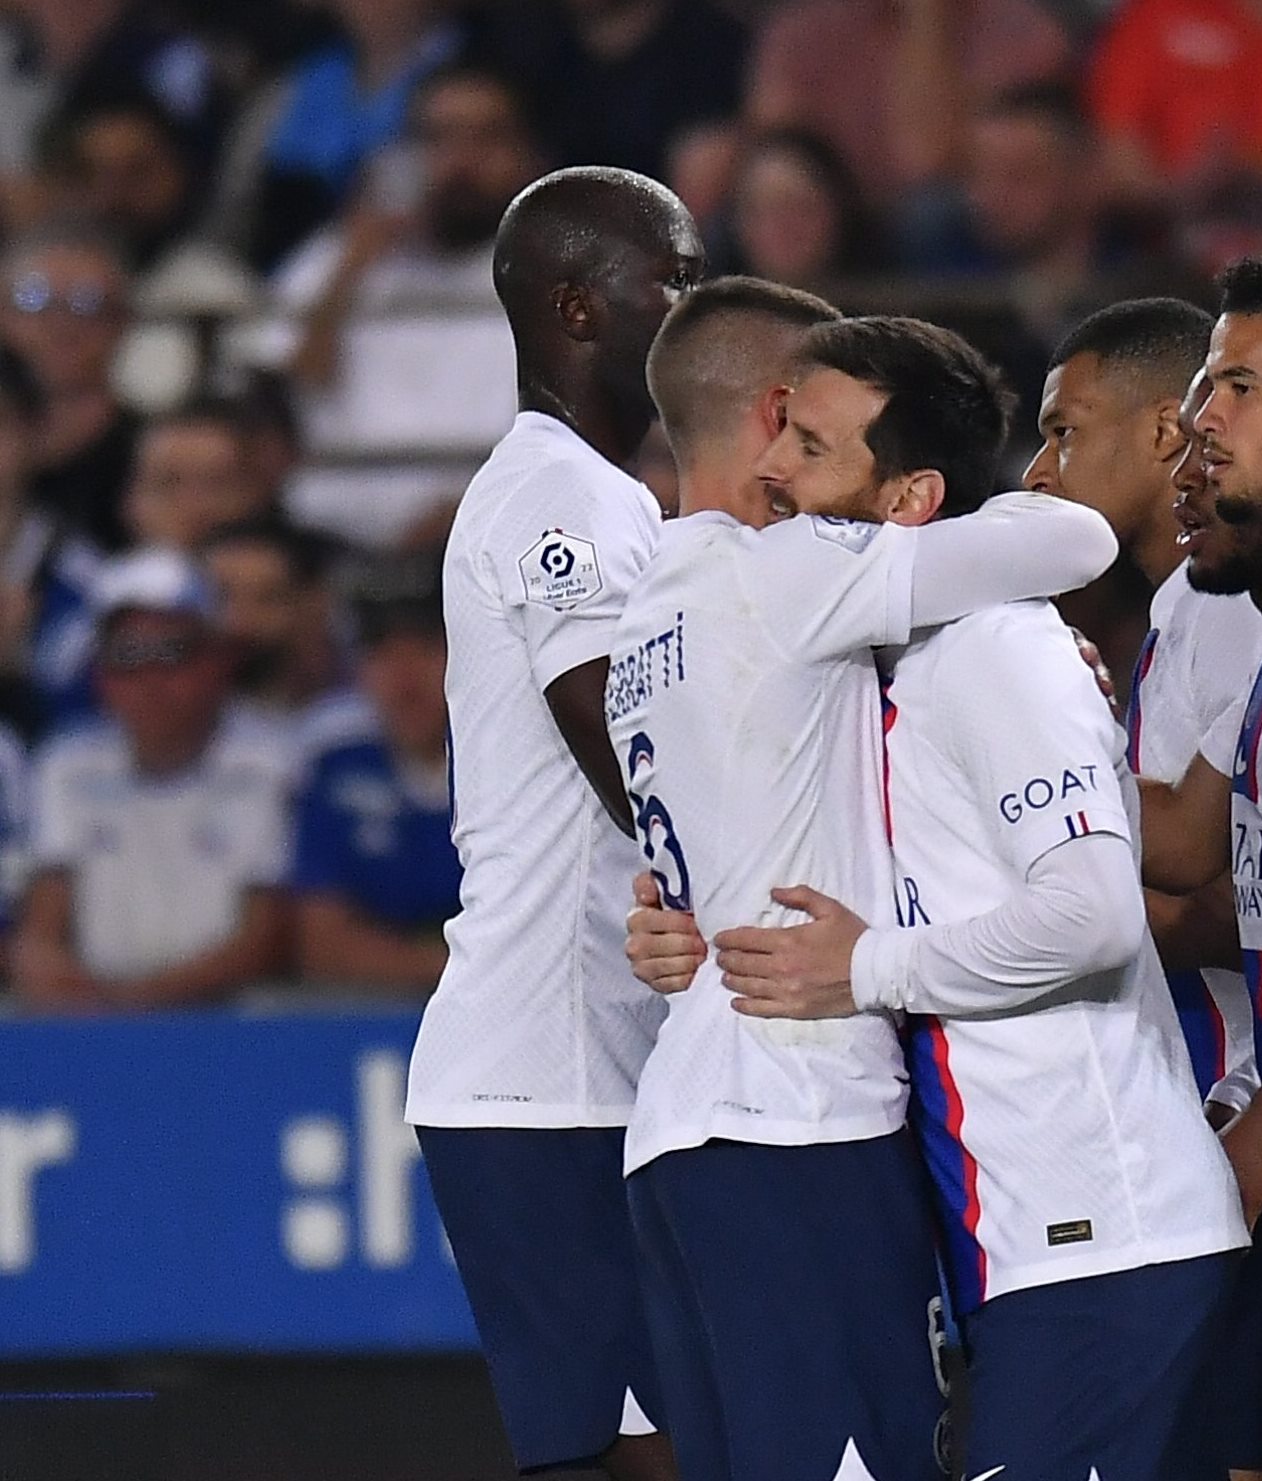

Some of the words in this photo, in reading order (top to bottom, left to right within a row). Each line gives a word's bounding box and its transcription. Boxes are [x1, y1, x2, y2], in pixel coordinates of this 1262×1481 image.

[546, 579, 574, 592] LIGUE
[628, 732, 691, 911] 6
[999, 765, 1097, 824] GOAT
